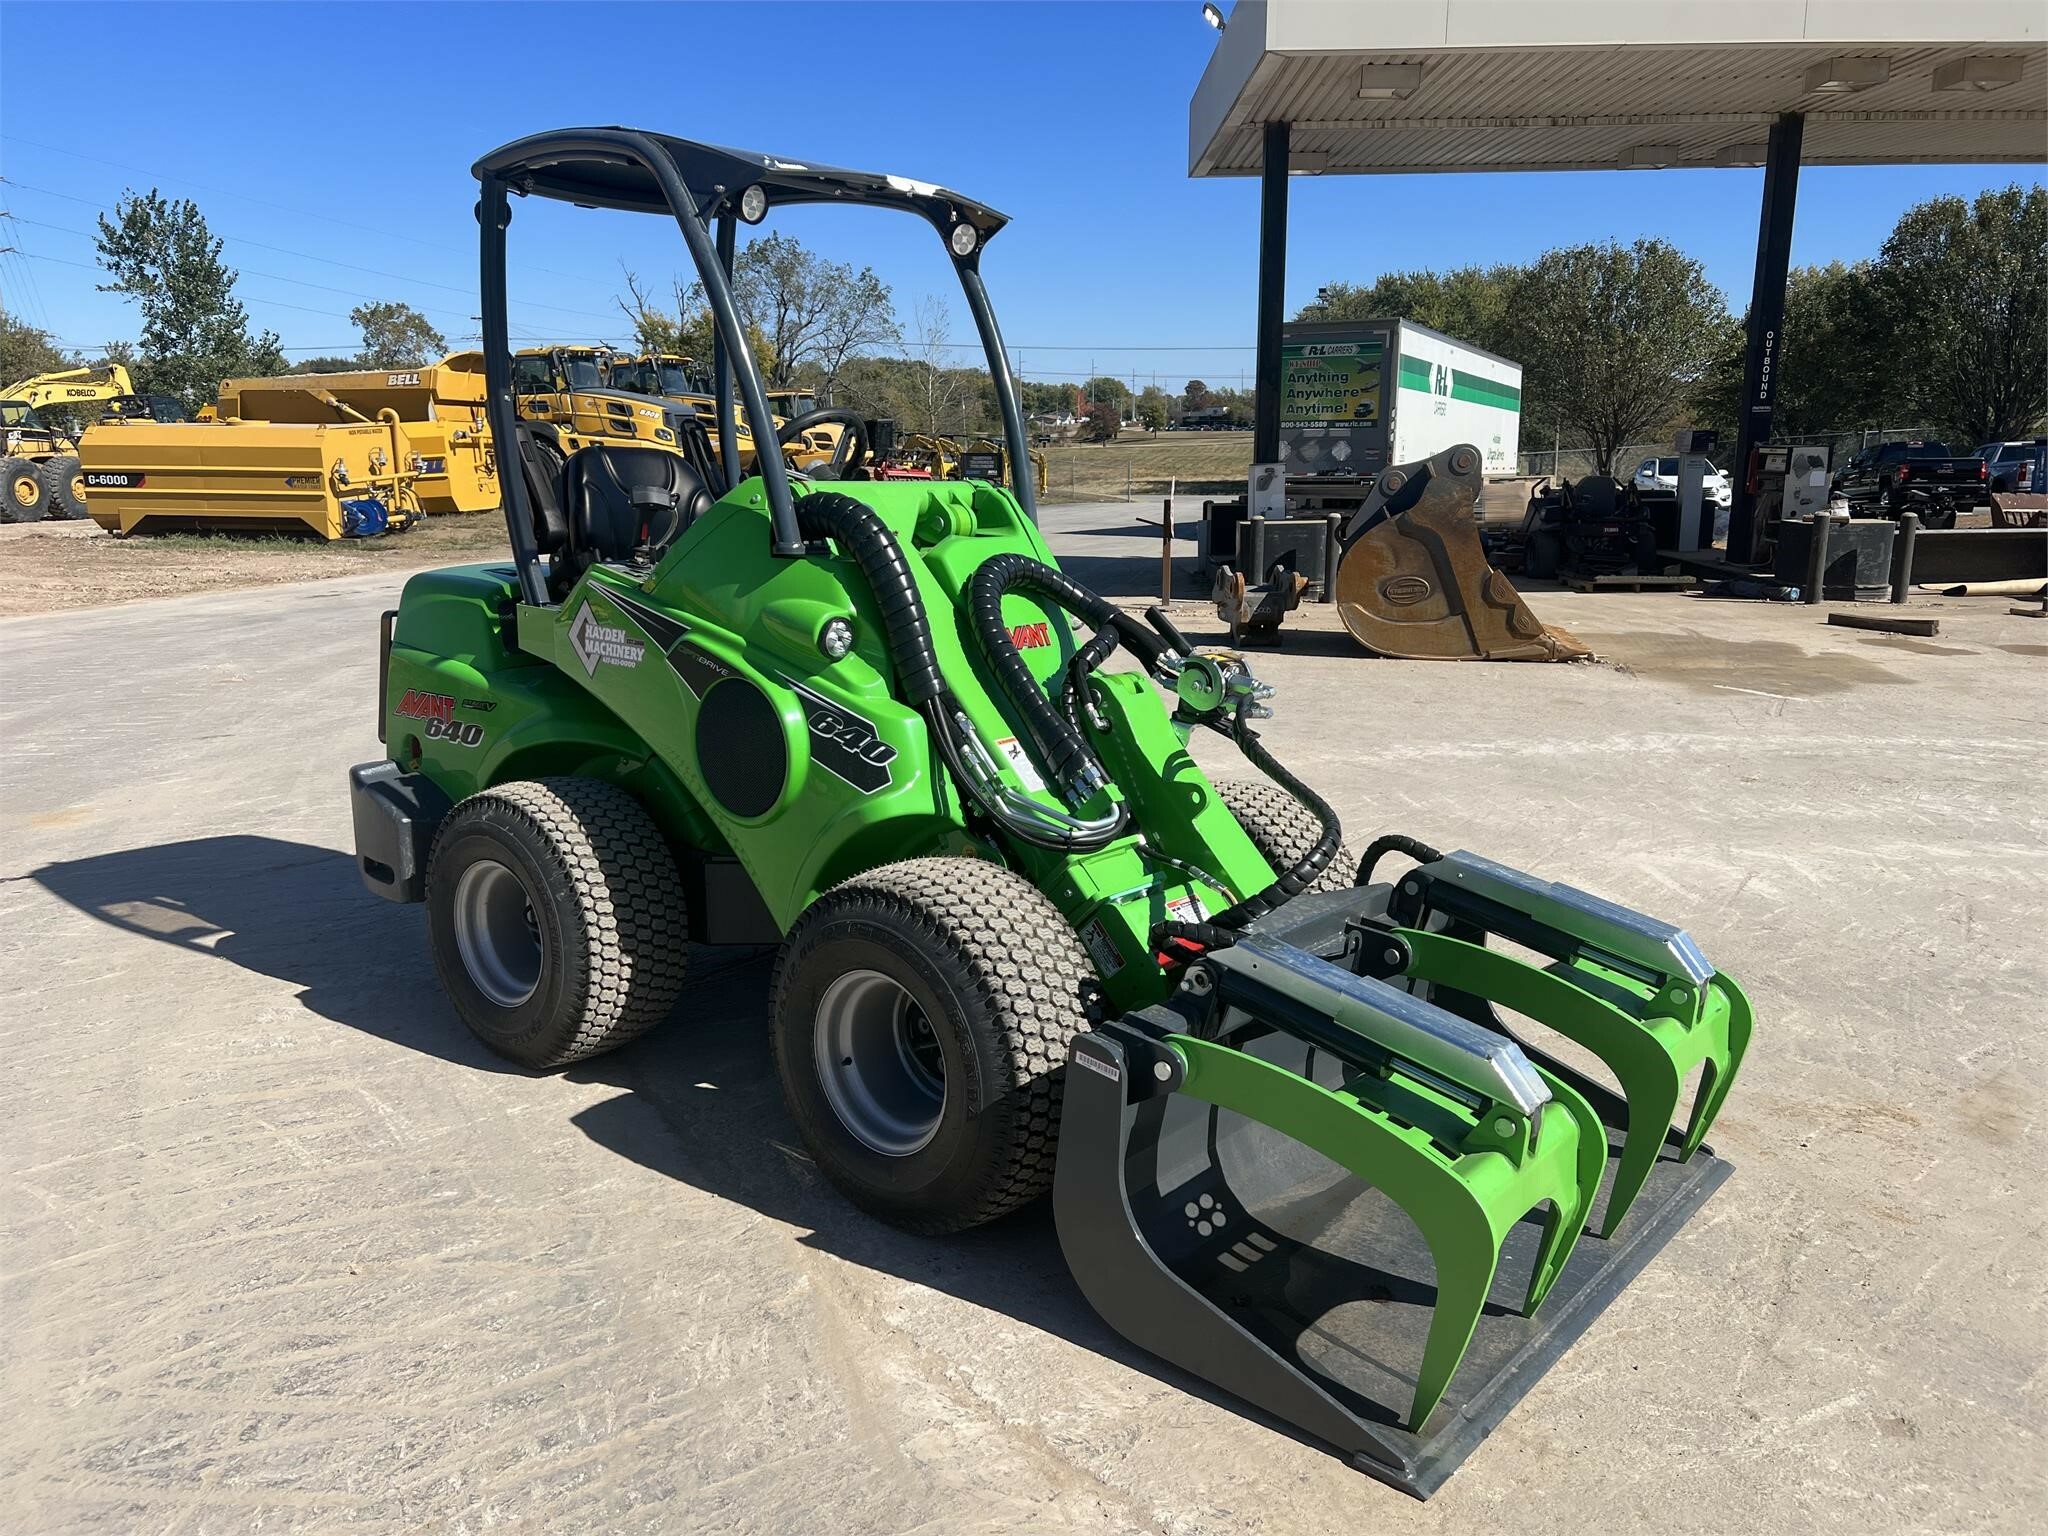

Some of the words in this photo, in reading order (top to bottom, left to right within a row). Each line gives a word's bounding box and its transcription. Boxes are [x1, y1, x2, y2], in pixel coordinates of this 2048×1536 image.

[1760, 331, 1774, 399] OUTBOUND
[387, 373, 421, 387] BELL
[1287, 371, 1349, 385] Anything
[66, 389, 97, 397] KOBELCO
[1286, 388, 1359, 401] Anywhere
[1286, 403, 1348, 416] Anytime!
[88, 474, 128, 486] G-6000
[291, 476, 320, 486] PREMIER
[585, 623, 626, 644] HAYDEN
[1005, 622, 1051, 650] VANT
[584, 639, 645, 663] MACHINERY
[393, 688, 456, 726] AVANT
[424, 716, 485, 748] 640
[808, 710, 898, 767] 640
